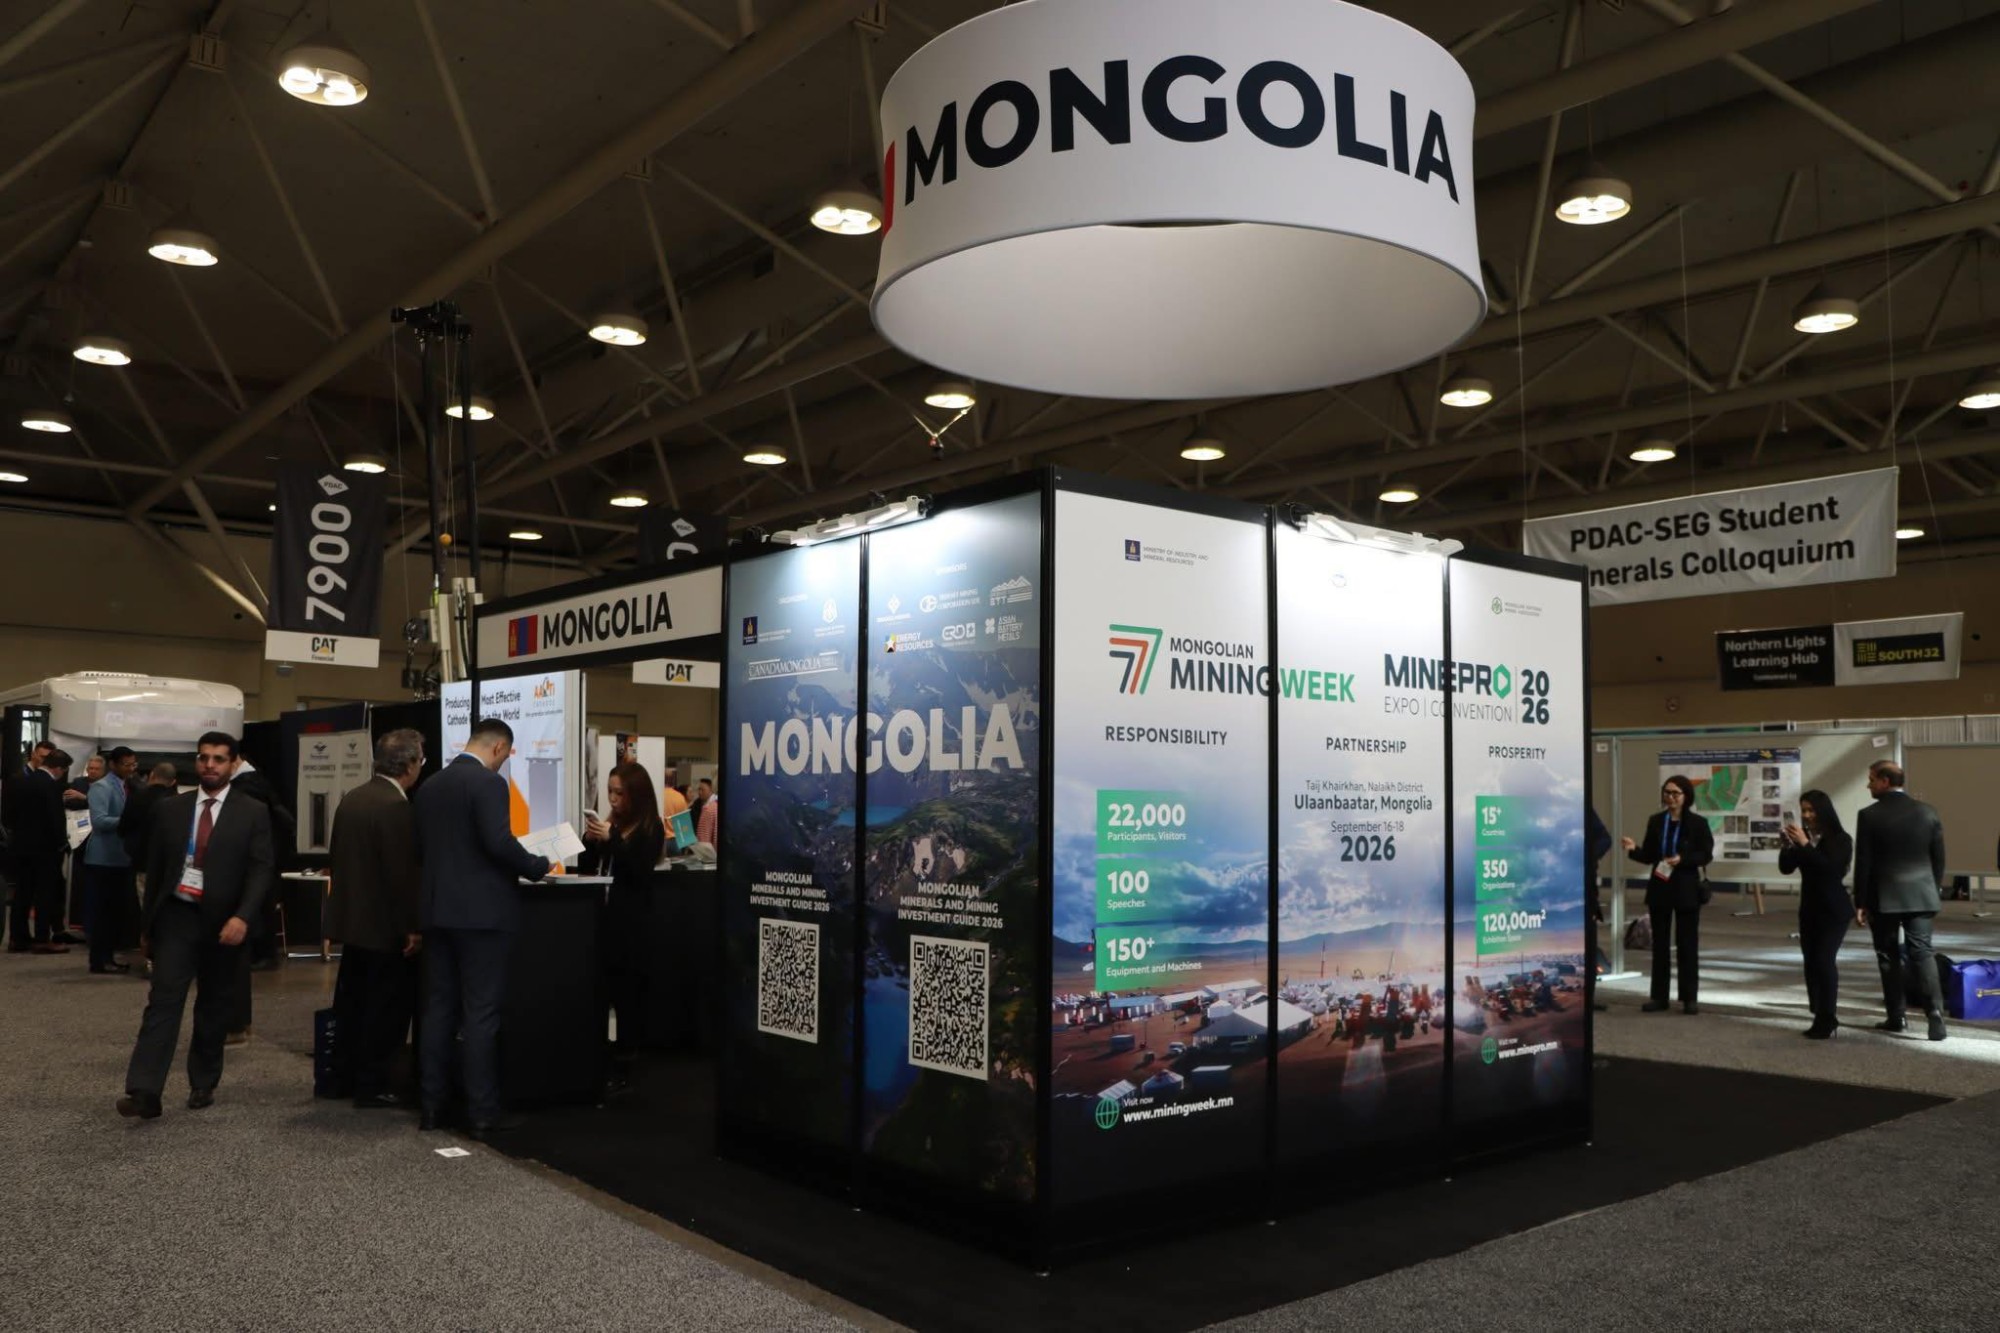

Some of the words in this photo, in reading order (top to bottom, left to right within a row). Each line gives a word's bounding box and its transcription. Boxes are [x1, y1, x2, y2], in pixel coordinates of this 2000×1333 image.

[905, 55, 1459, 205] MONGOLIA
[1570, 512, 1710, 552] PDAC-SEG
[1719, 497, 1839, 533] Student
[305, 502, 352, 622] 7900
[1590, 558, 1673, 587] nerals
[1681, 539, 1855, 577] Colloquium
[543, 591, 673, 649] MONGOLIA
[311, 637, 338, 653] CAT
[896, 640, 934, 652] RESOURCES
[1170, 637, 1254, 659] MONGOLIAN
[1725, 639, 1782, 652] Northern
[1785, 635, 1826, 651] Lights
[1733, 654, 1789, 669] Learning
[1792, 652, 1818, 665] Hub
[666, 663, 693, 681] CAT
[1521, 669, 1550, 697] 20
[445, 697, 470, 710] Producing
[496, 691, 520, 704] Effective
[1384, 696, 1419, 716] EXPO
[1430, 700, 1512, 722] CONVENTION
[503, 708, 520, 720] World
[1521, 697, 1550, 725] 26
[741, 703, 1024, 776] MONGOLIA
[1105, 726, 1227, 746] RESPONSIBILITY
[1326, 737, 1407, 753] PARTNERSHIP
[1488, 745, 1546, 760] PROSPERITY
[1397, 782, 1423, 792] District
[1294, 794, 1378, 812] Ulaanbaatar,
[1381, 795, 1432, 814] Mongolia
[1108, 803, 1185, 831] 22,000
[1107, 831, 1156, 842] Participants,
[1159, 831, 1186, 841] Visitors
[1331, 820, 1382, 834] September
[1383, 821, 1405, 832] 16-18
[1340, 835, 1396, 862] 2026
[765, 871, 812, 885] MONGOLIAN
[1482, 859, 1508, 878] 350
[752, 883, 784, 897] MINERALS
[786, 886, 800, 898] AND
[802, 887, 827, 899] MINING
[918, 882, 979, 898] MONGOLIAN
[1107, 870, 1149, 894] 100
[750, 895, 790, 908] INVESTMENT
[791, 899, 812, 911] GUIDE
[813, 900, 830, 912] 2026
[900, 896, 942, 910] MINERALS
[944, 899, 963, 912] AND
[965, 901, 999, 914] MINING
[1107, 899, 1145, 910] Speeches
[898, 909, 950, 924] INVESTMENT
[953, 912, 980, 927] GUIDE
[982, 915, 1003, 929] 2026
[1106, 937, 1155, 962] 150+
[1106, 964, 1150, 977] Equipment
[1152, 963, 1165, 974] and
[1167, 961, 1202, 973] Machines
[1123, 1096, 1233, 1123] www.miningweek.mn
[1124, 1097, 1138, 1107] Visit
